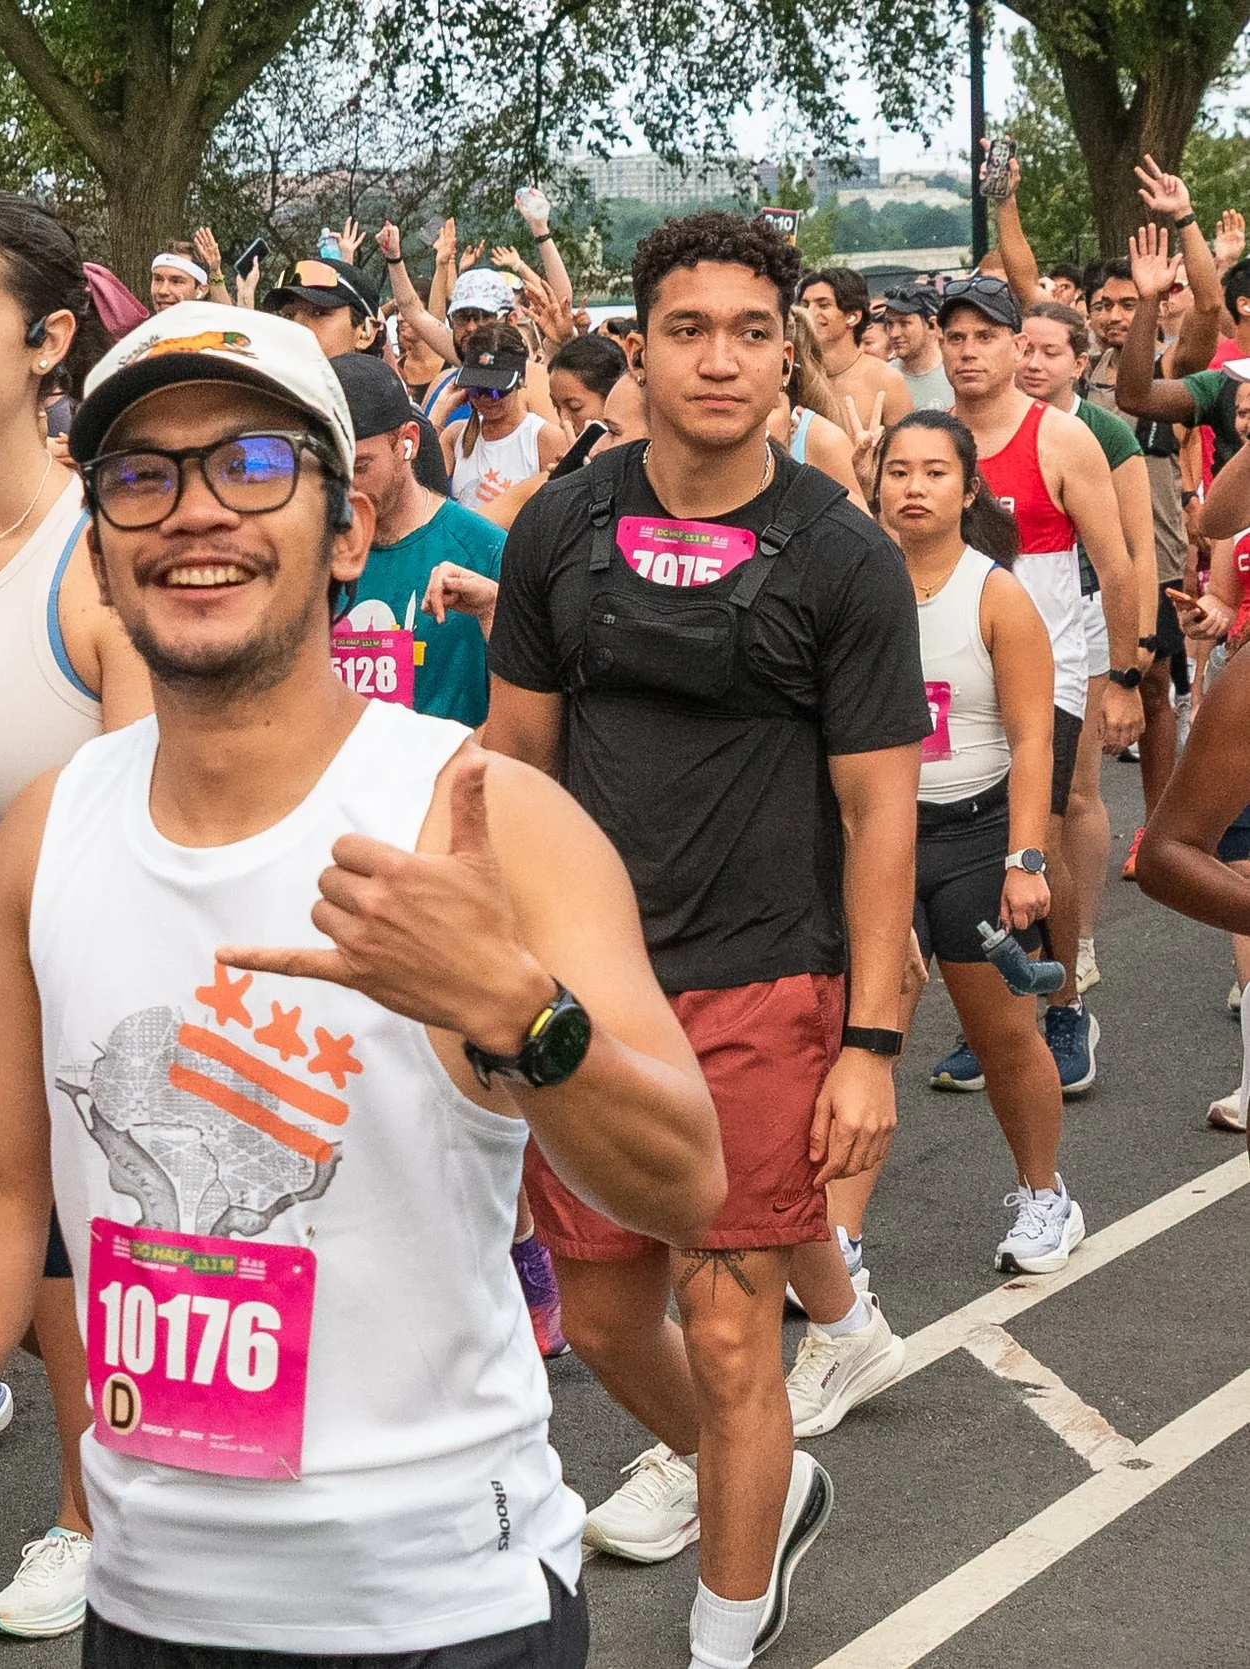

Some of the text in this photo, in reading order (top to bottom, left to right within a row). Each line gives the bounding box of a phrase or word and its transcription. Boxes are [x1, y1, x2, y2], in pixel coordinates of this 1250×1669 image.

[99, 1280, 282, 1392] 10176
[110, 1379, 135, 1429] D
[489, 1479, 511, 1552] BROOKS
